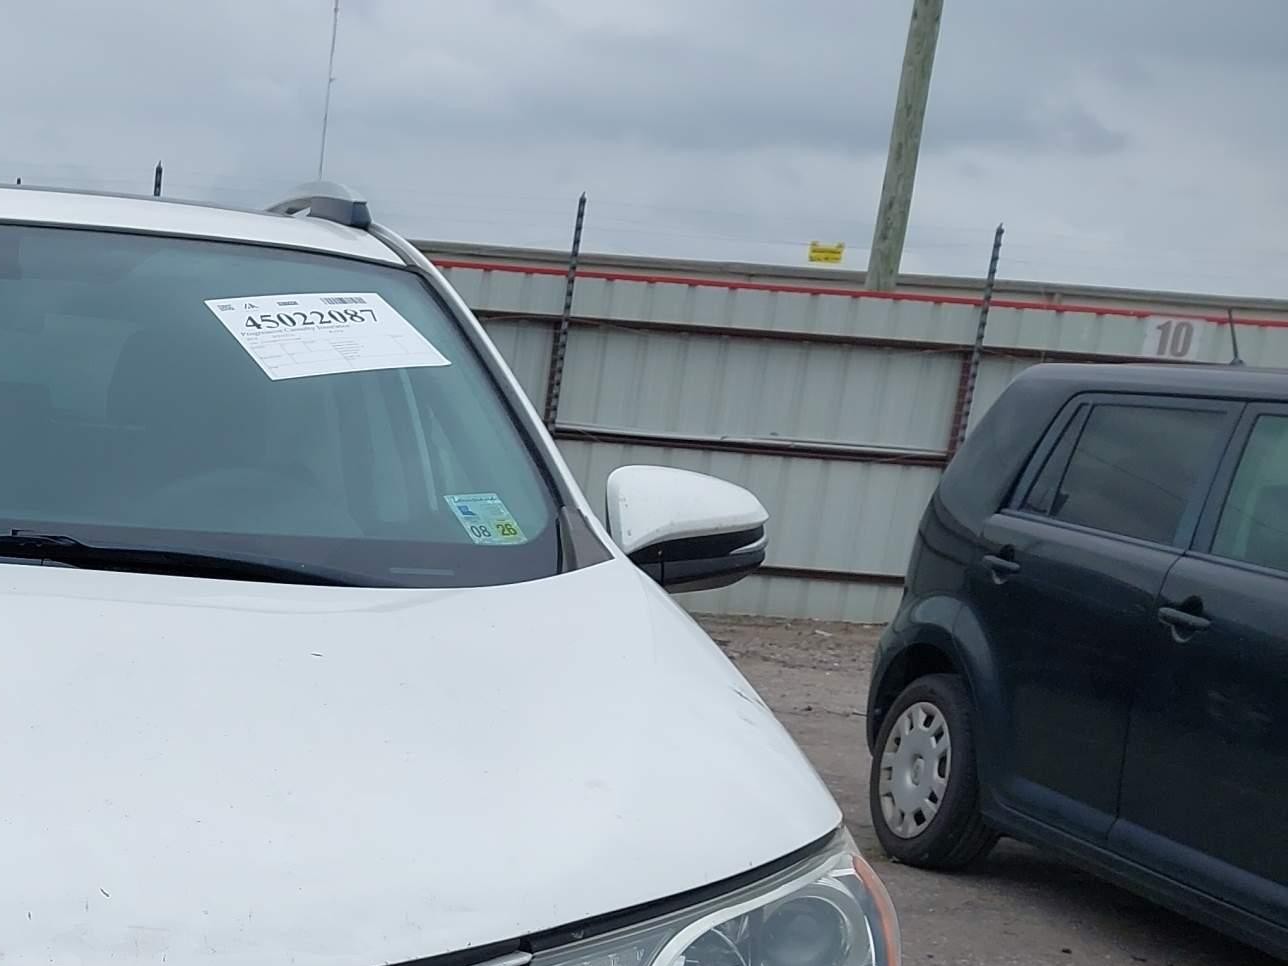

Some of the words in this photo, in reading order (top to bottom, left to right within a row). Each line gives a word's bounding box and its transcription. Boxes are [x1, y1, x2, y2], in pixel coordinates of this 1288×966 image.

[245, 308, 379, 330] 45022087
[1156, 320, 1194, 357] 10
[470, 525, 492, 538] 08
[496, 523, 518, 536] 26
